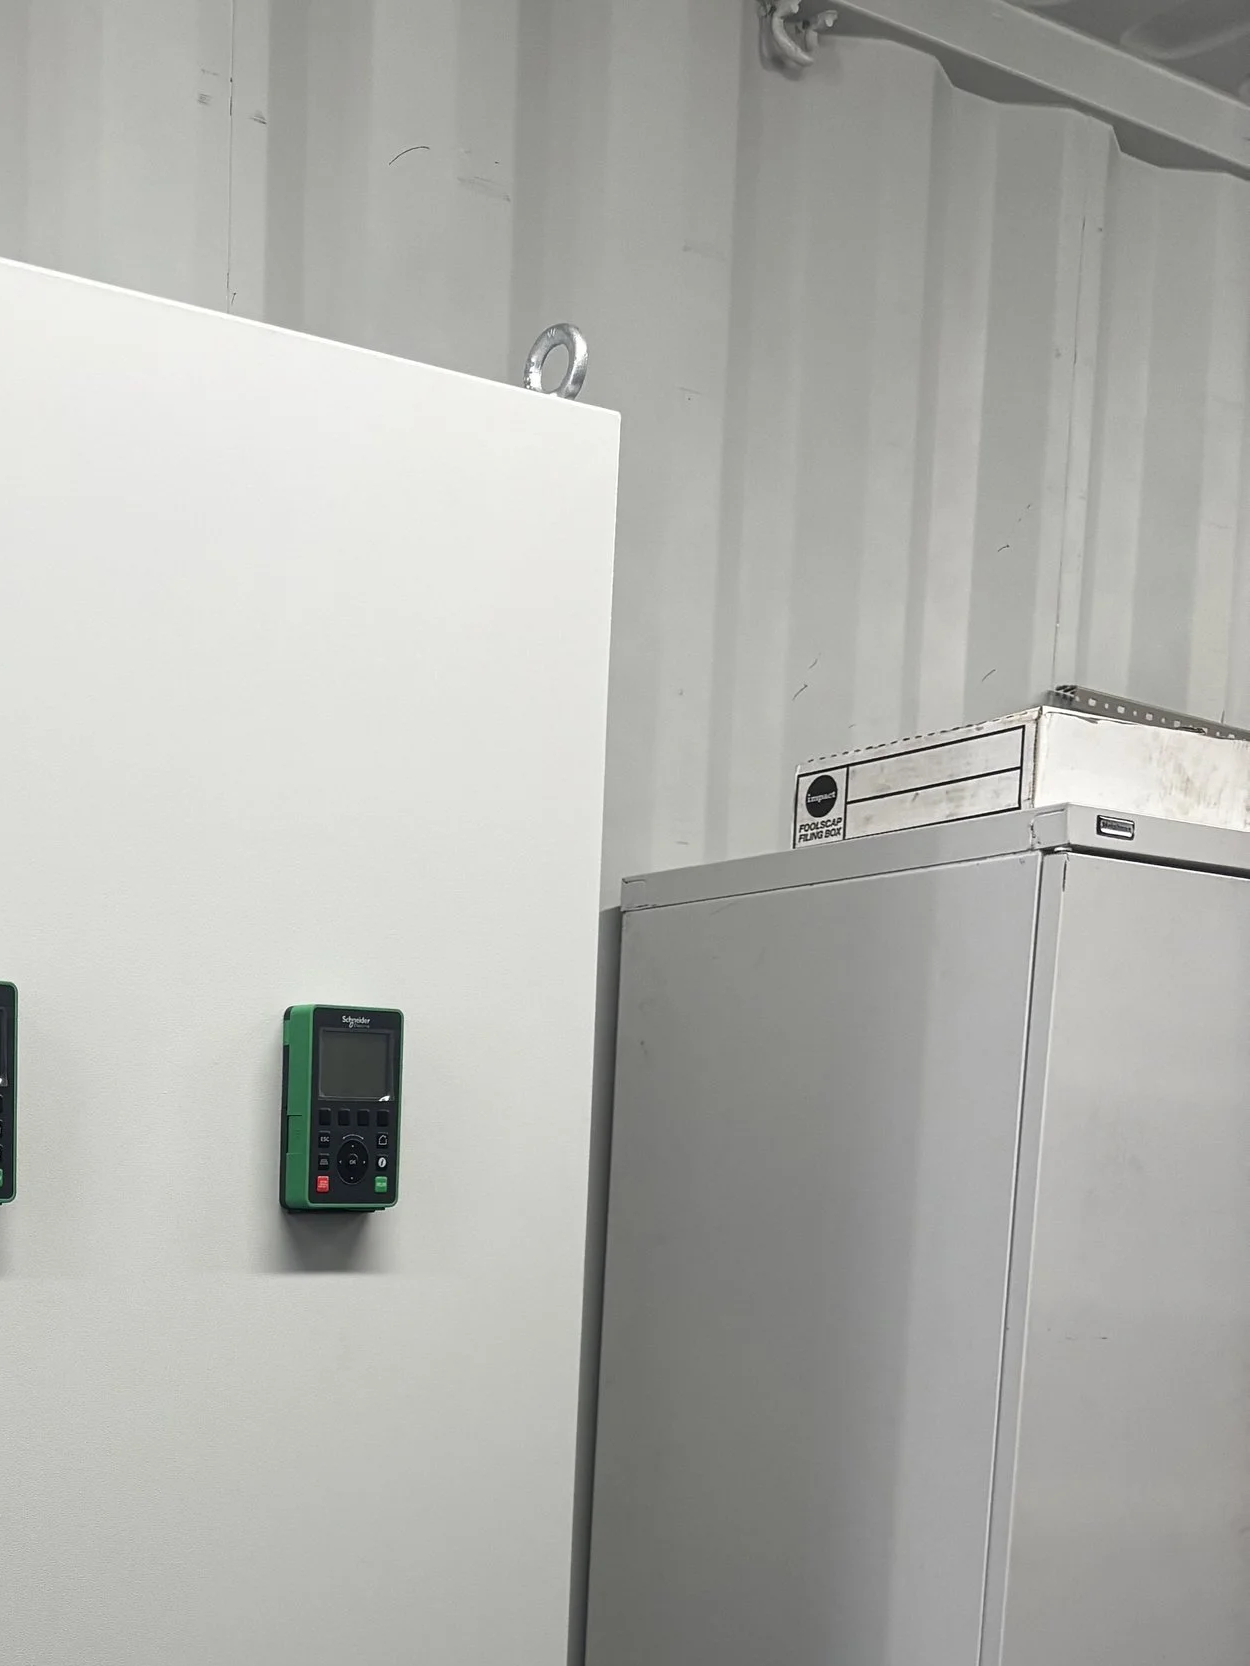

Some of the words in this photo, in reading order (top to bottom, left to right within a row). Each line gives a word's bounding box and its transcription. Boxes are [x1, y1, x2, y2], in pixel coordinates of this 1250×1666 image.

[807, 791, 836, 803] impact
[798, 817, 842, 833] FOOLSCAP
[798, 830, 823, 843] FILING
[824, 827, 842, 838] BOX
[341, 1015, 371, 1028] Schneider
